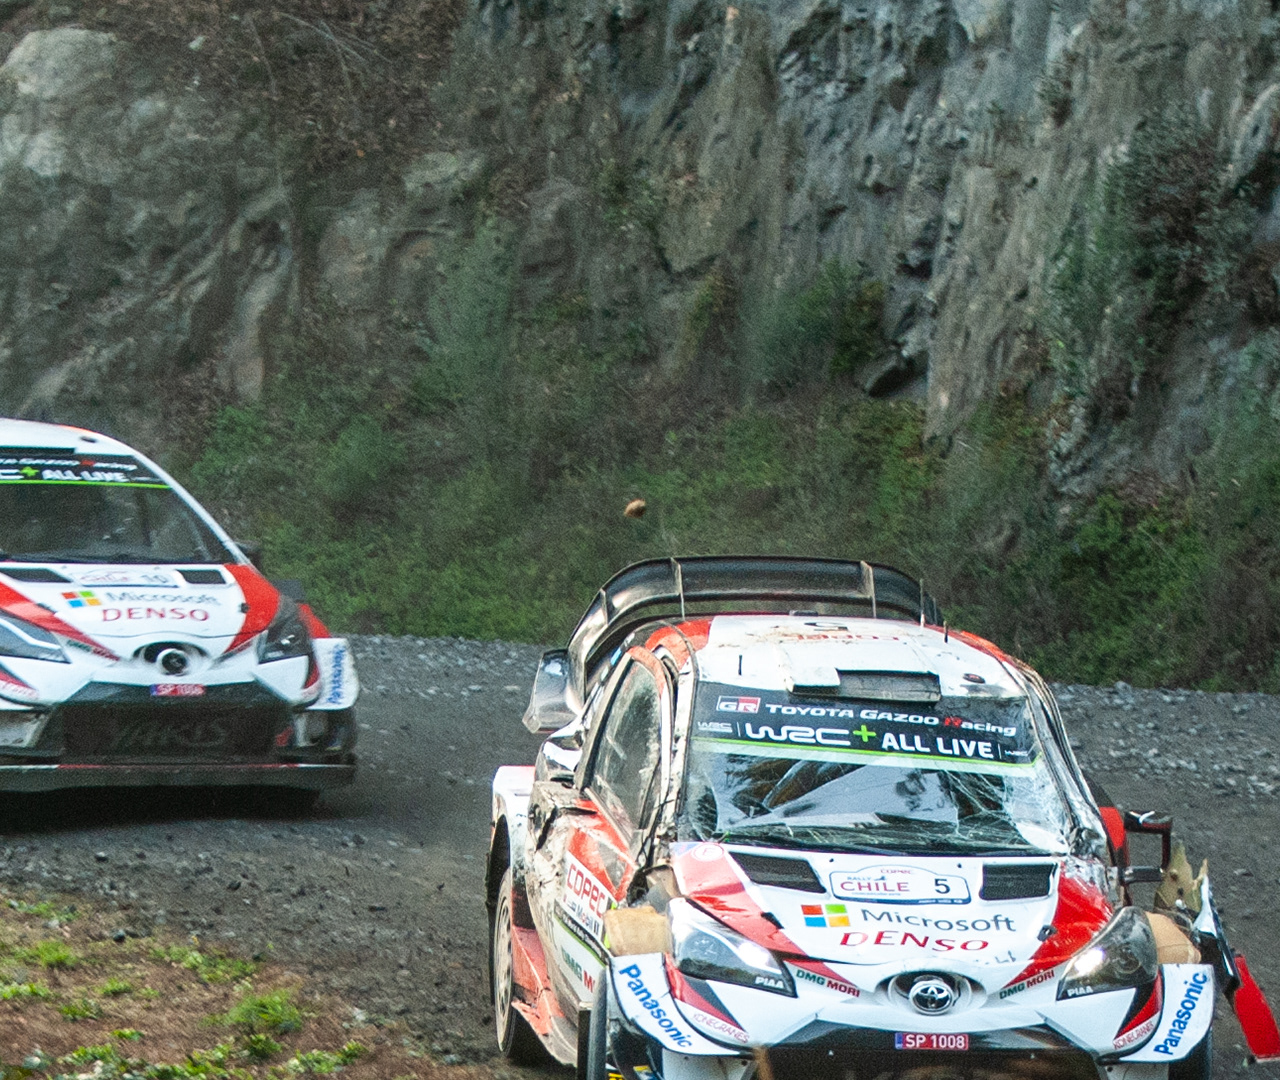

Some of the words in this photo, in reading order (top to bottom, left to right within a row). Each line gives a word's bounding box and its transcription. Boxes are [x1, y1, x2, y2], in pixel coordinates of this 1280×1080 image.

[101, 607, 209, 622] DENSO
[765, 703, 854, 719] TOYOTA
[859, 708, 940, 726] GAZOO
[943, 715, 1017, 738] Racing
[881, 732, 931, 754] ALL
[935, 736, 995, 760] LIVE
[839, 881, 911, 893] CHILE
[934, 878, 951, 895] 5
[860, 908, 1017, 932] Microsoft
[839, 930, 990, 952] DENSO
[754, 976, 785, 989] PIAA
[796, 969, 826, 986] DMG
[826, 980, 860, 998] MORI
[999, 982, 1025, 1000] DMG
[1026, 970, 1056, 989] MORI
[1067, 985, 1094, 997] PIAA
[618, 963, 693, 1049] Panasonic
[1152, 972, 1208, 1056] Panasonic
[905, 1034, 926, 1049] SP
[930, 1034, 965, 1049] 1008
